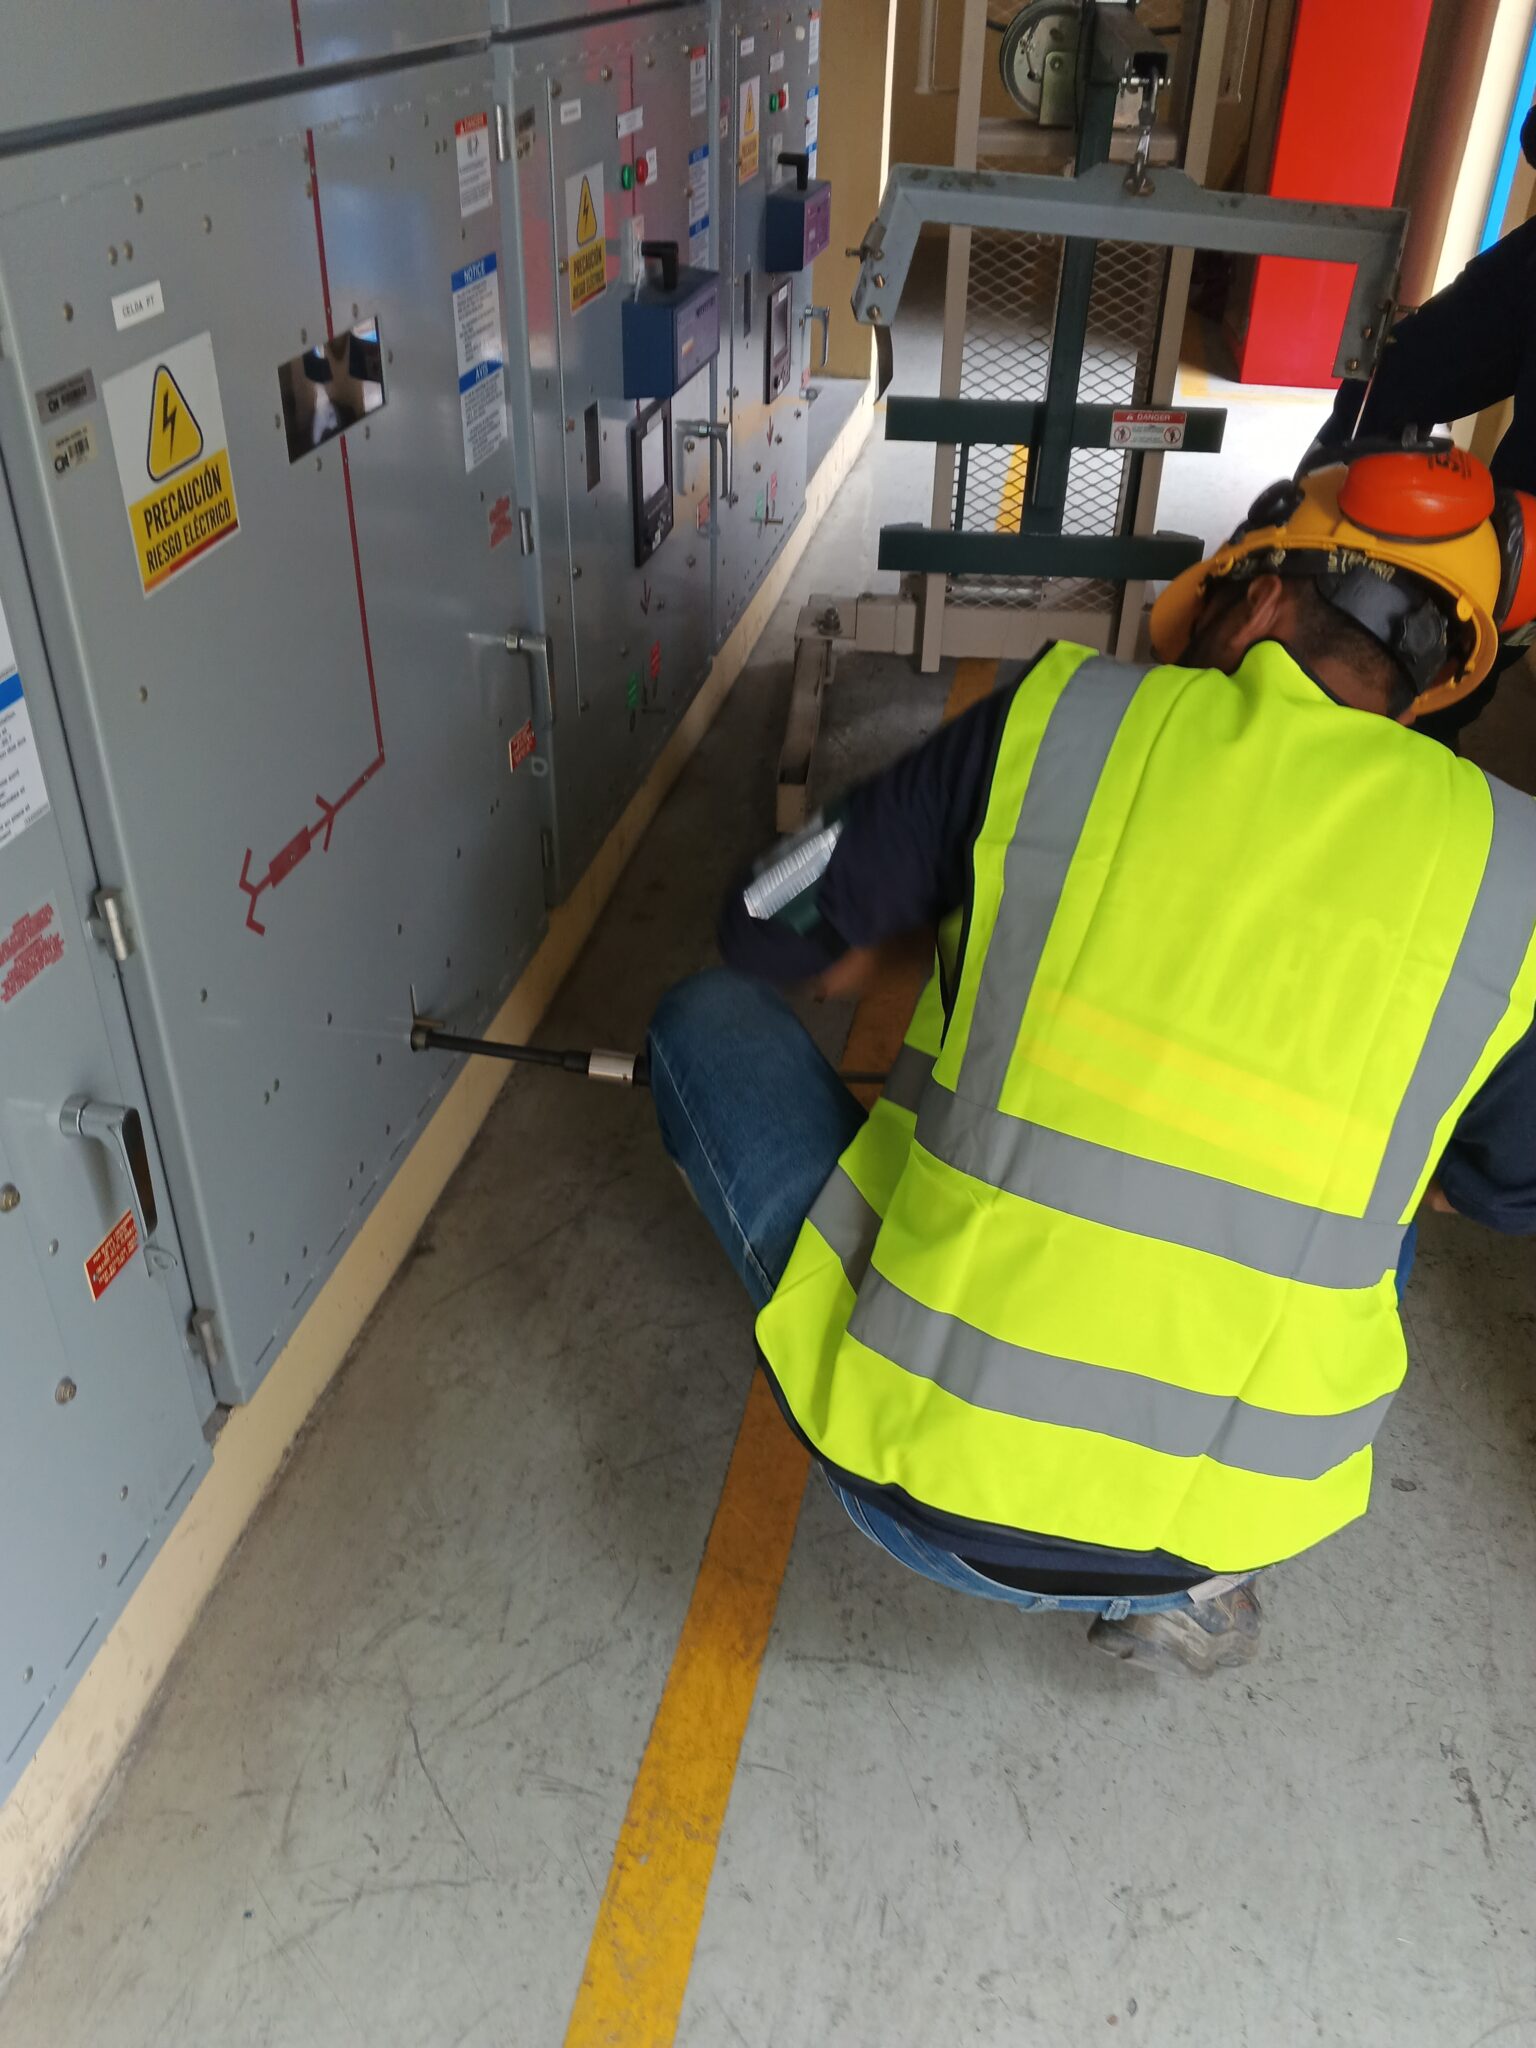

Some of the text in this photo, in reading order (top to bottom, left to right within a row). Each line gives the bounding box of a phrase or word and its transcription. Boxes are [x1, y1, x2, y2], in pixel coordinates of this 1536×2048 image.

[1136, 413, 1171, 422] DANGER
[144, 463, 222, 540] PRECAUCIÓN
[146, 497, 231, 574] RIESGO ELÉCTRICO
